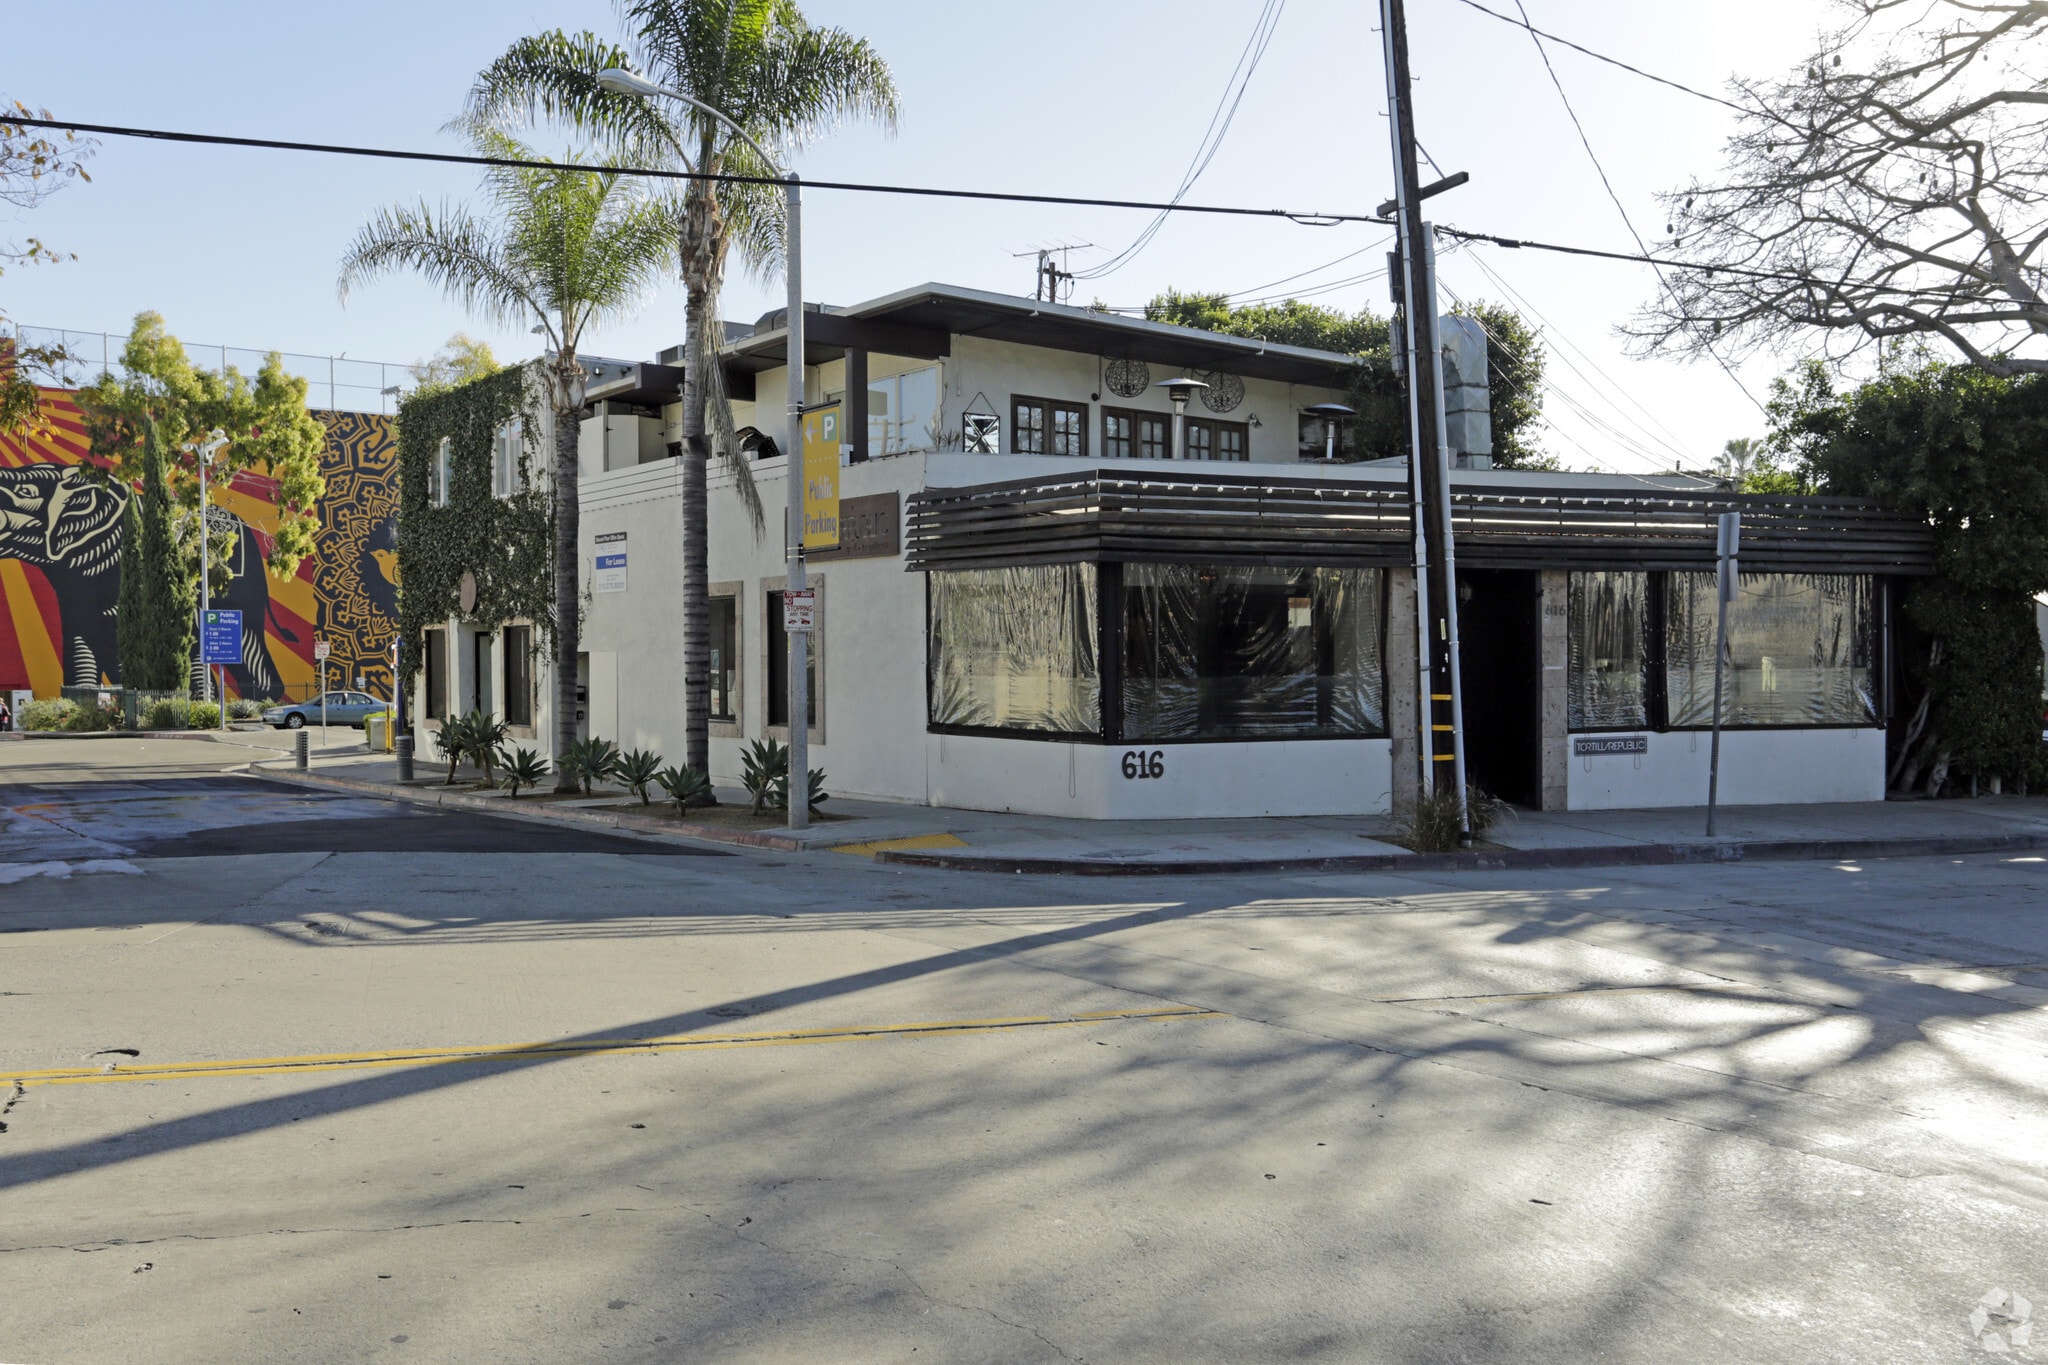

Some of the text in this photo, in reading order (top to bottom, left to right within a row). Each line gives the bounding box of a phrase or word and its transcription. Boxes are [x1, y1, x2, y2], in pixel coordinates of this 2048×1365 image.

[824, 416, 834, 440] P
[809, 475, 833, 501] Public
[805, 512, 837, 538] Parking
[612, 557, 625, 565] Lease
[785, 597, 793, 605] NO
[207, 613, 217, 623] P
[1121, 750, 1165, 780] 616
